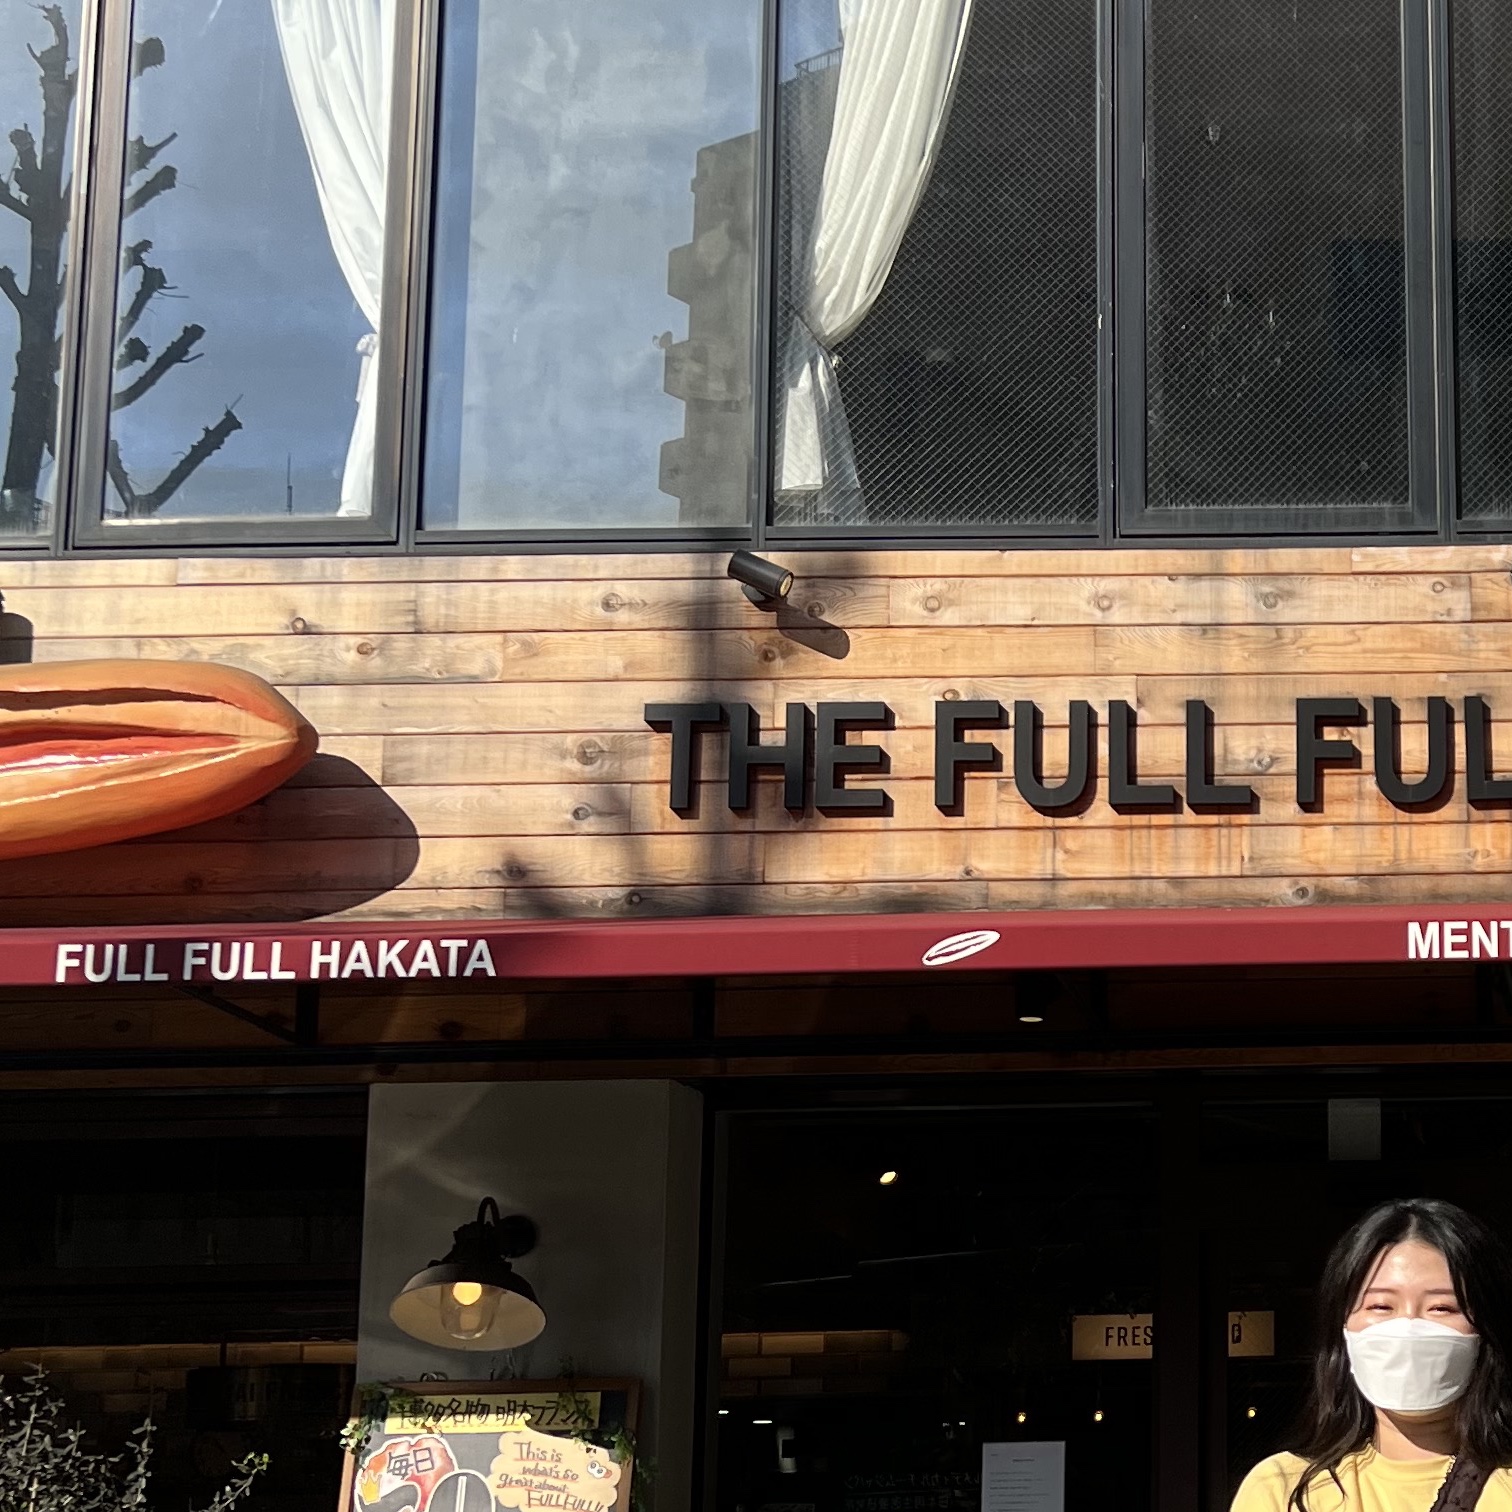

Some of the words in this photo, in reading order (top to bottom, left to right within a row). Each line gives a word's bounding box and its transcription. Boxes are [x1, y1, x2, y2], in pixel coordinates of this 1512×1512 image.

[644, 701, 894, 817] THE
[934, 700, 1259, 816] FULL
[55, 943, 168, 982] FULL
[182, 942, 296, 981] FULL
[309, 939, 496, 979] HAKATA
[386, 1448, 436, 1480] 毎日
[513, 1441, 548, 1461] This
[551, 1449, 563, 1463] is
[497, 1473, 534, 1489] great
[534, 1479, 569, 1493] about
[522, 1462, 560, 1479] what's
